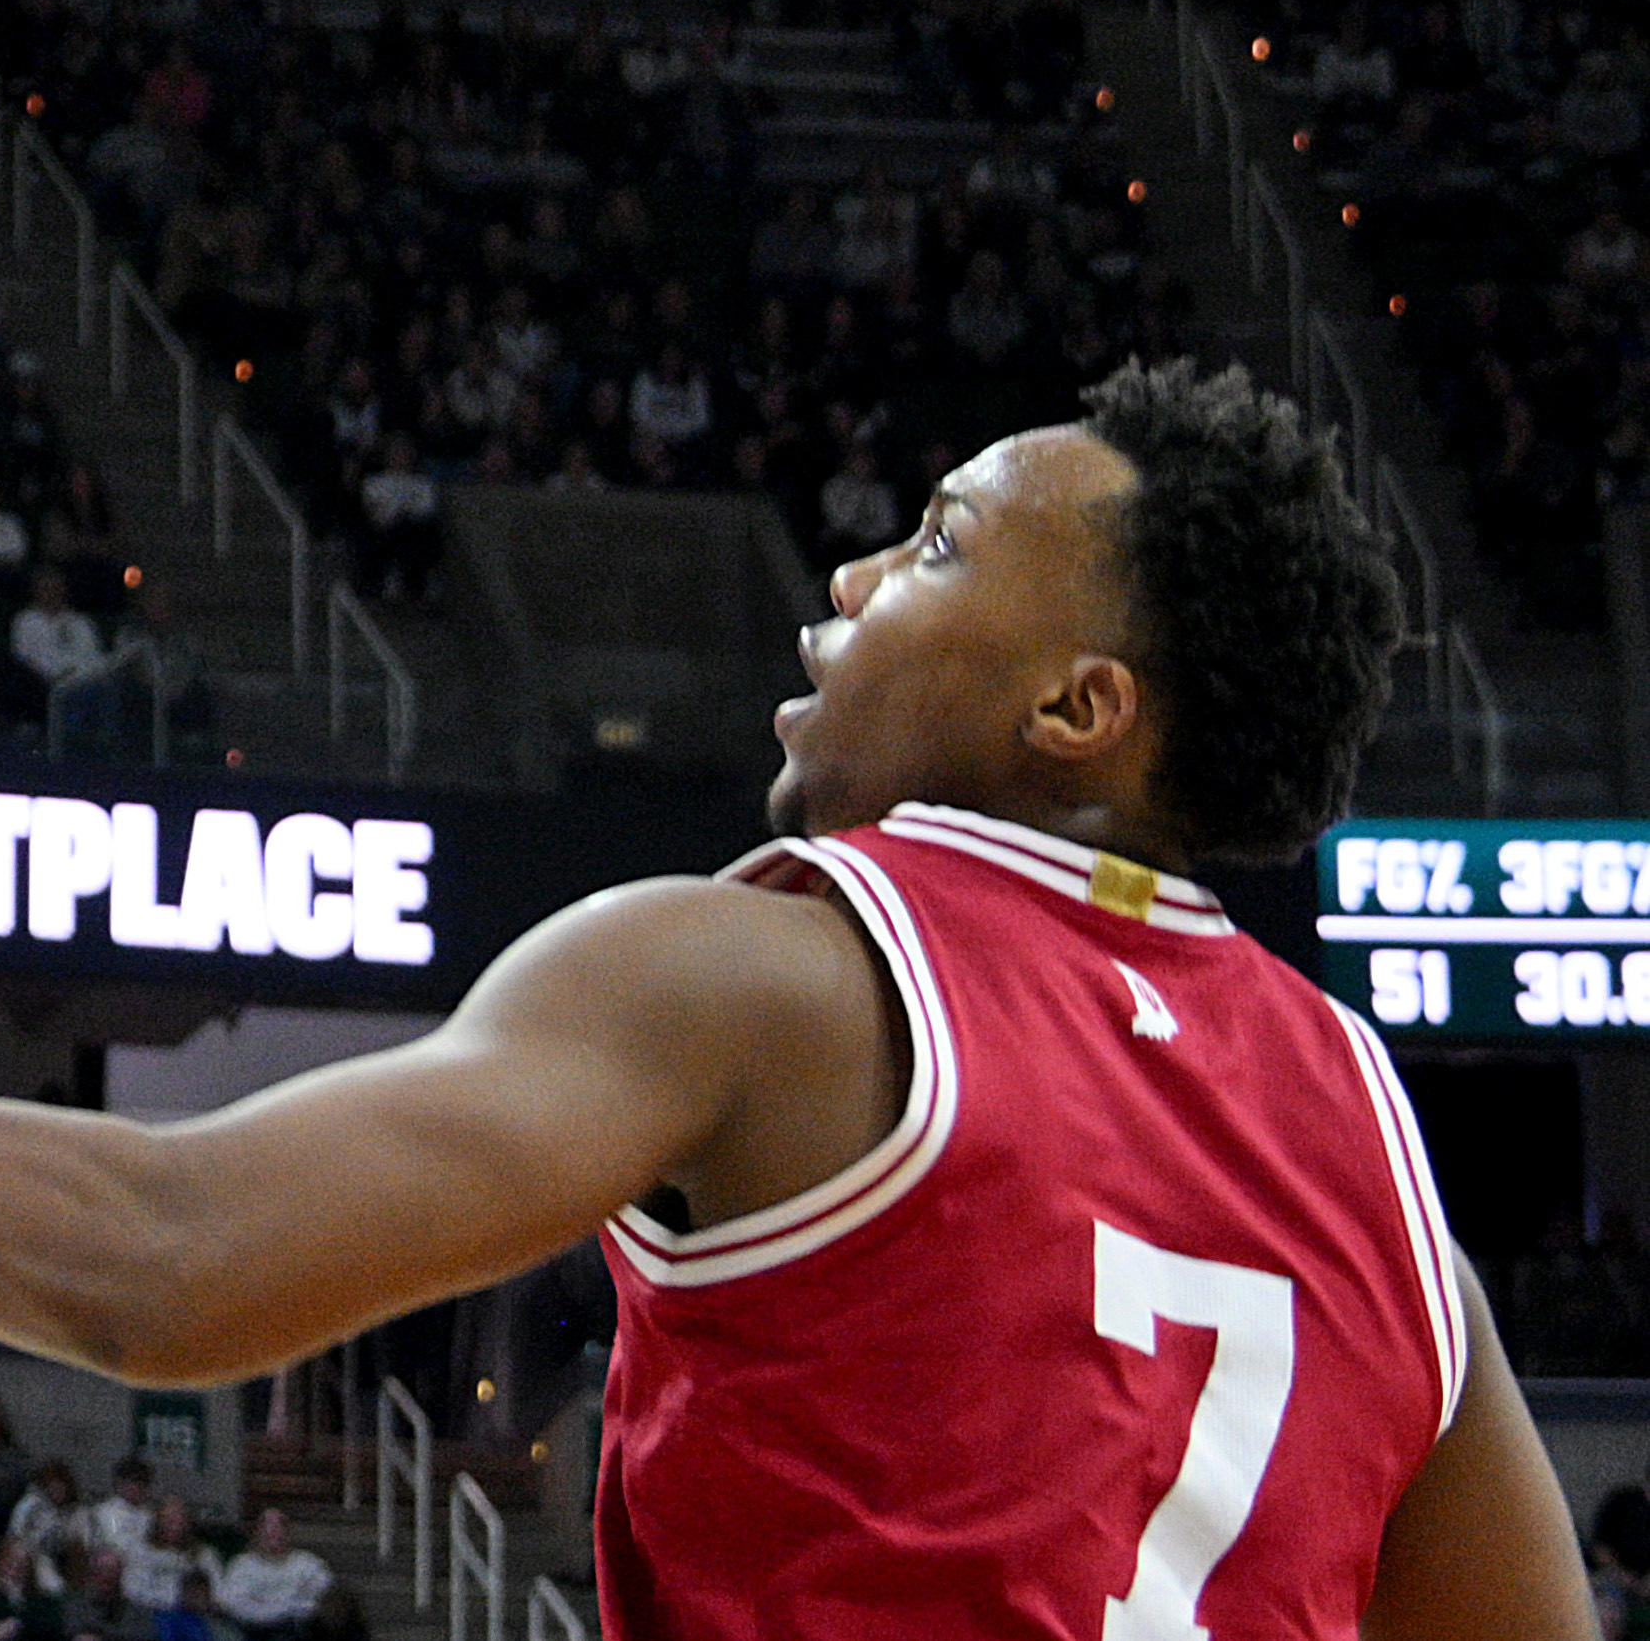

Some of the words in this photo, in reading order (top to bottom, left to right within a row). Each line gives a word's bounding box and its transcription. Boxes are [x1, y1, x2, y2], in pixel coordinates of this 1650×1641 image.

[1336, 837, 1474, 914] FG%
[1370, 948, 1451, 1025] 51
[1093, 1220, 1295, 1641] 7
